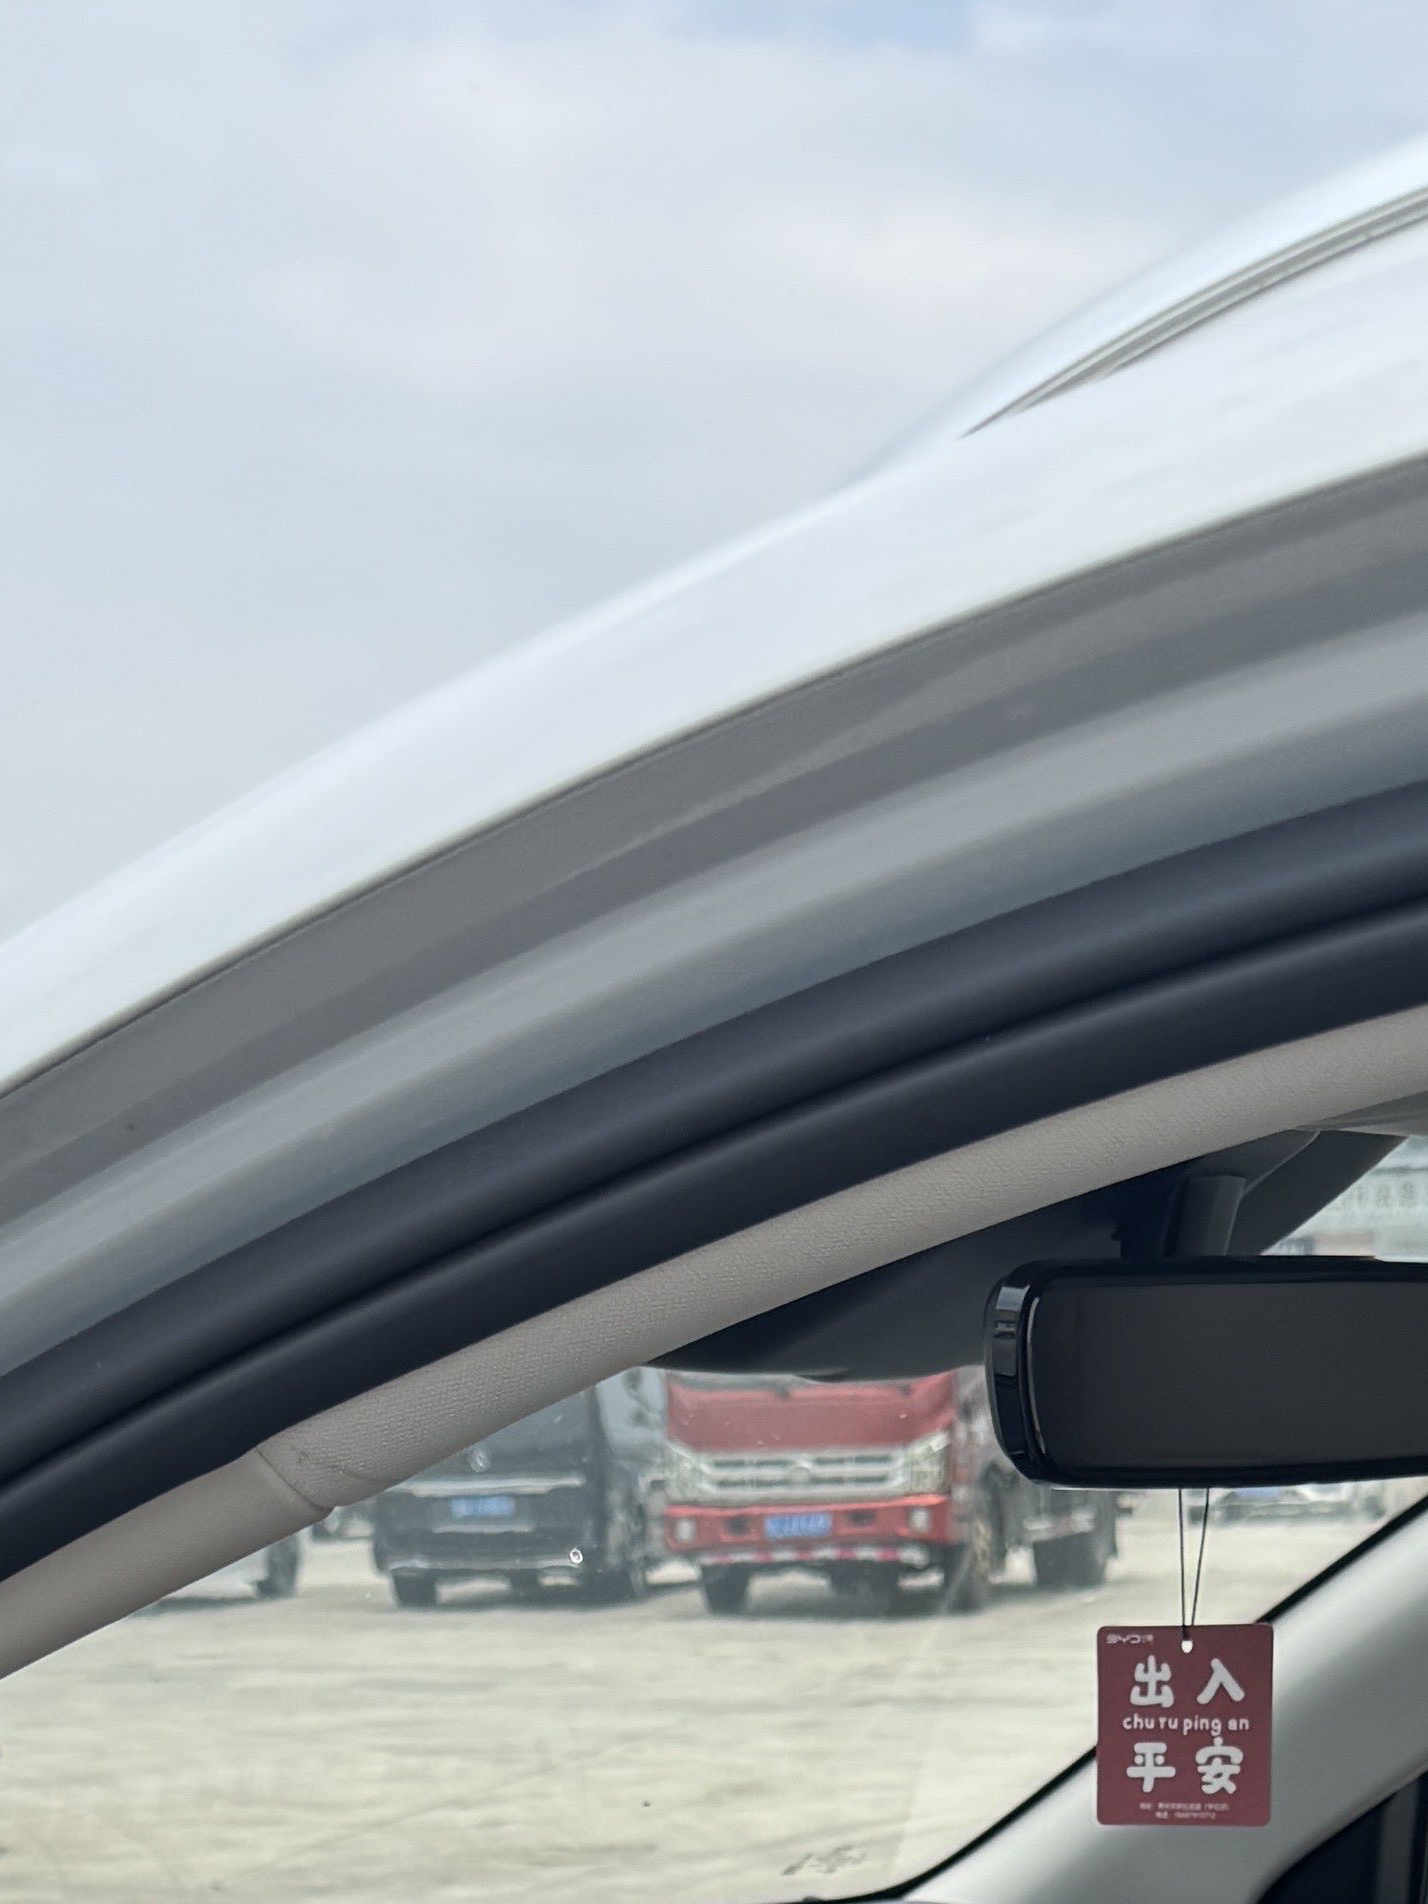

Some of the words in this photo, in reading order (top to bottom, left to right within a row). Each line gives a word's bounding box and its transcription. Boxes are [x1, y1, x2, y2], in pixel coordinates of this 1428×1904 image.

[1130, 1654, 1245, 1708] 出入
[1122, 1713, 1155, 1730] chu
[1183, 1716, 1222, 1736] ping
[1228, 1718, 1250, 1730] an
[1126, 1736, 1244, 1795] 平安
